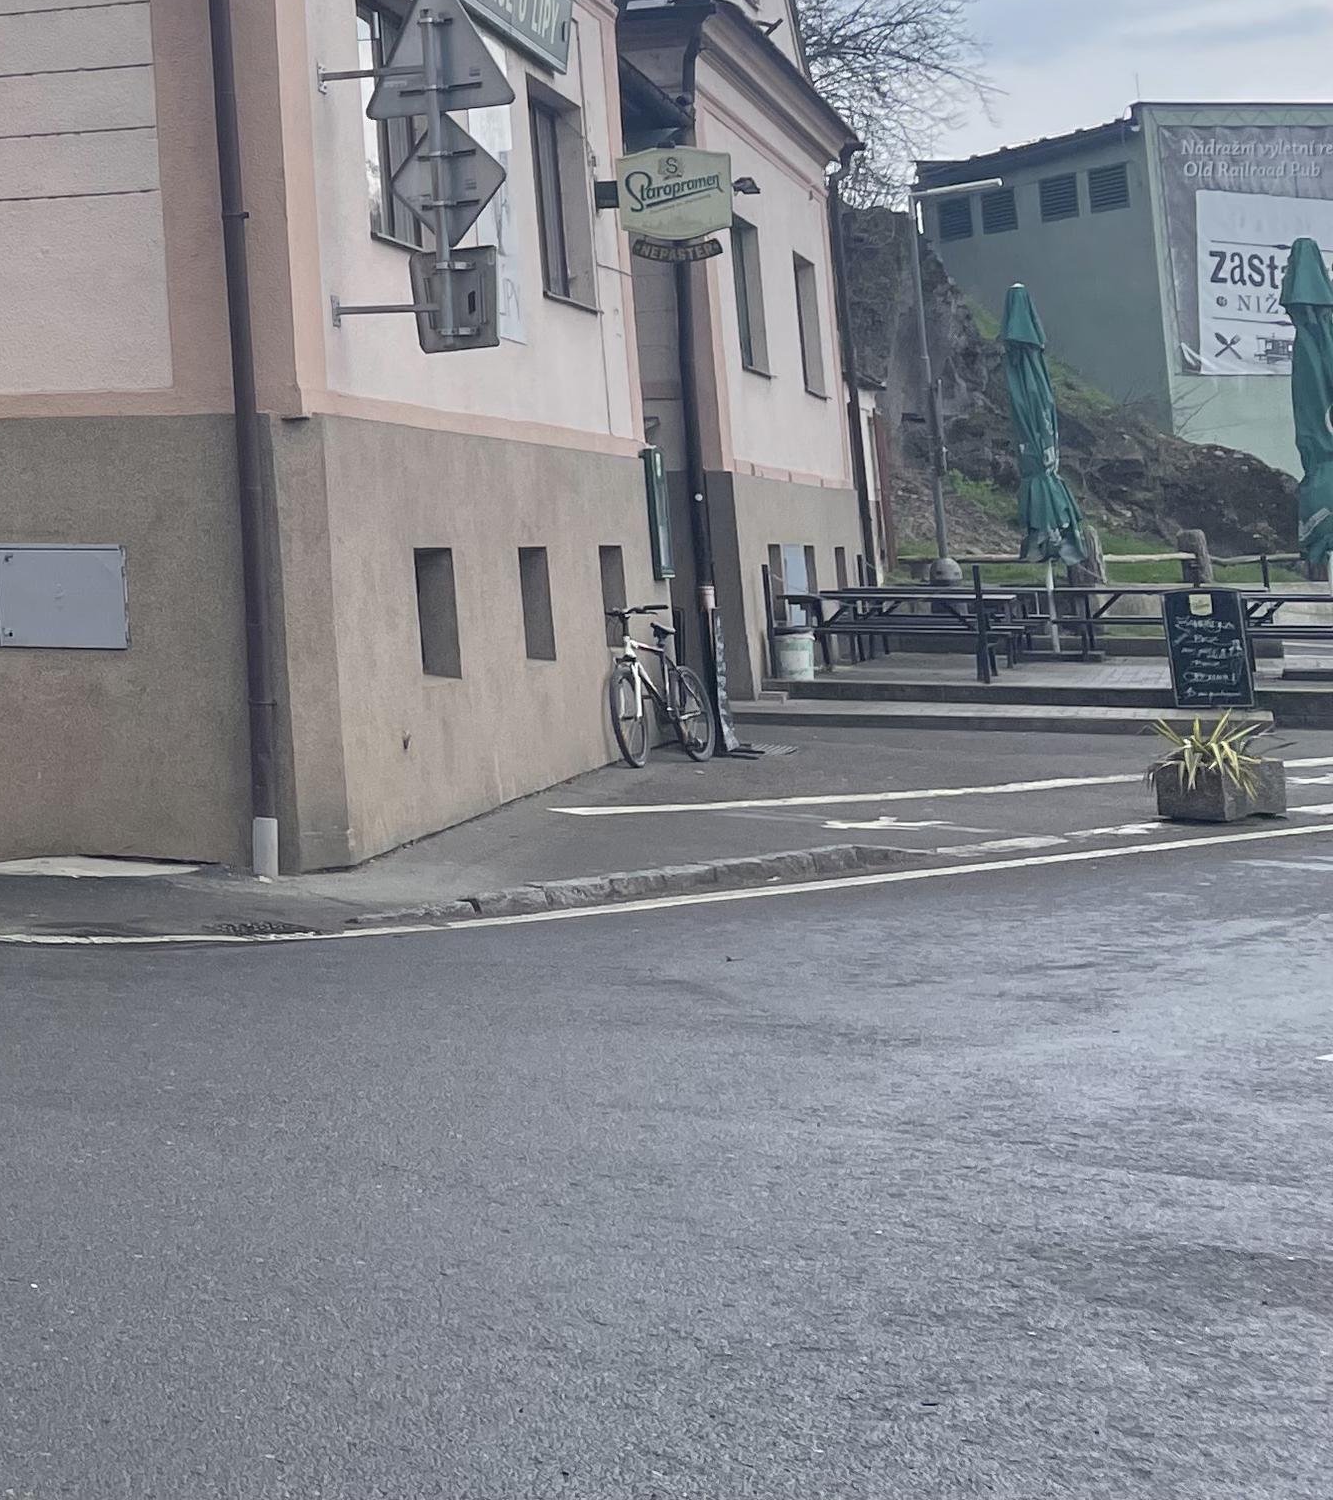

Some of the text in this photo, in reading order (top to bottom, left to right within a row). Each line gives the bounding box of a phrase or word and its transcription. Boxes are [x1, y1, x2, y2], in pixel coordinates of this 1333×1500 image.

[1180, 138, 1256, 157] Nádražní
[665, 156, 678, 174] S
[1183, 160, 1322, 180] Old Railroad Pub
[625, 171, 725, 213] Staropramen
[1208, 250, 1287, 290] zast
[1237, 293, 1283, 315] NIŽ
